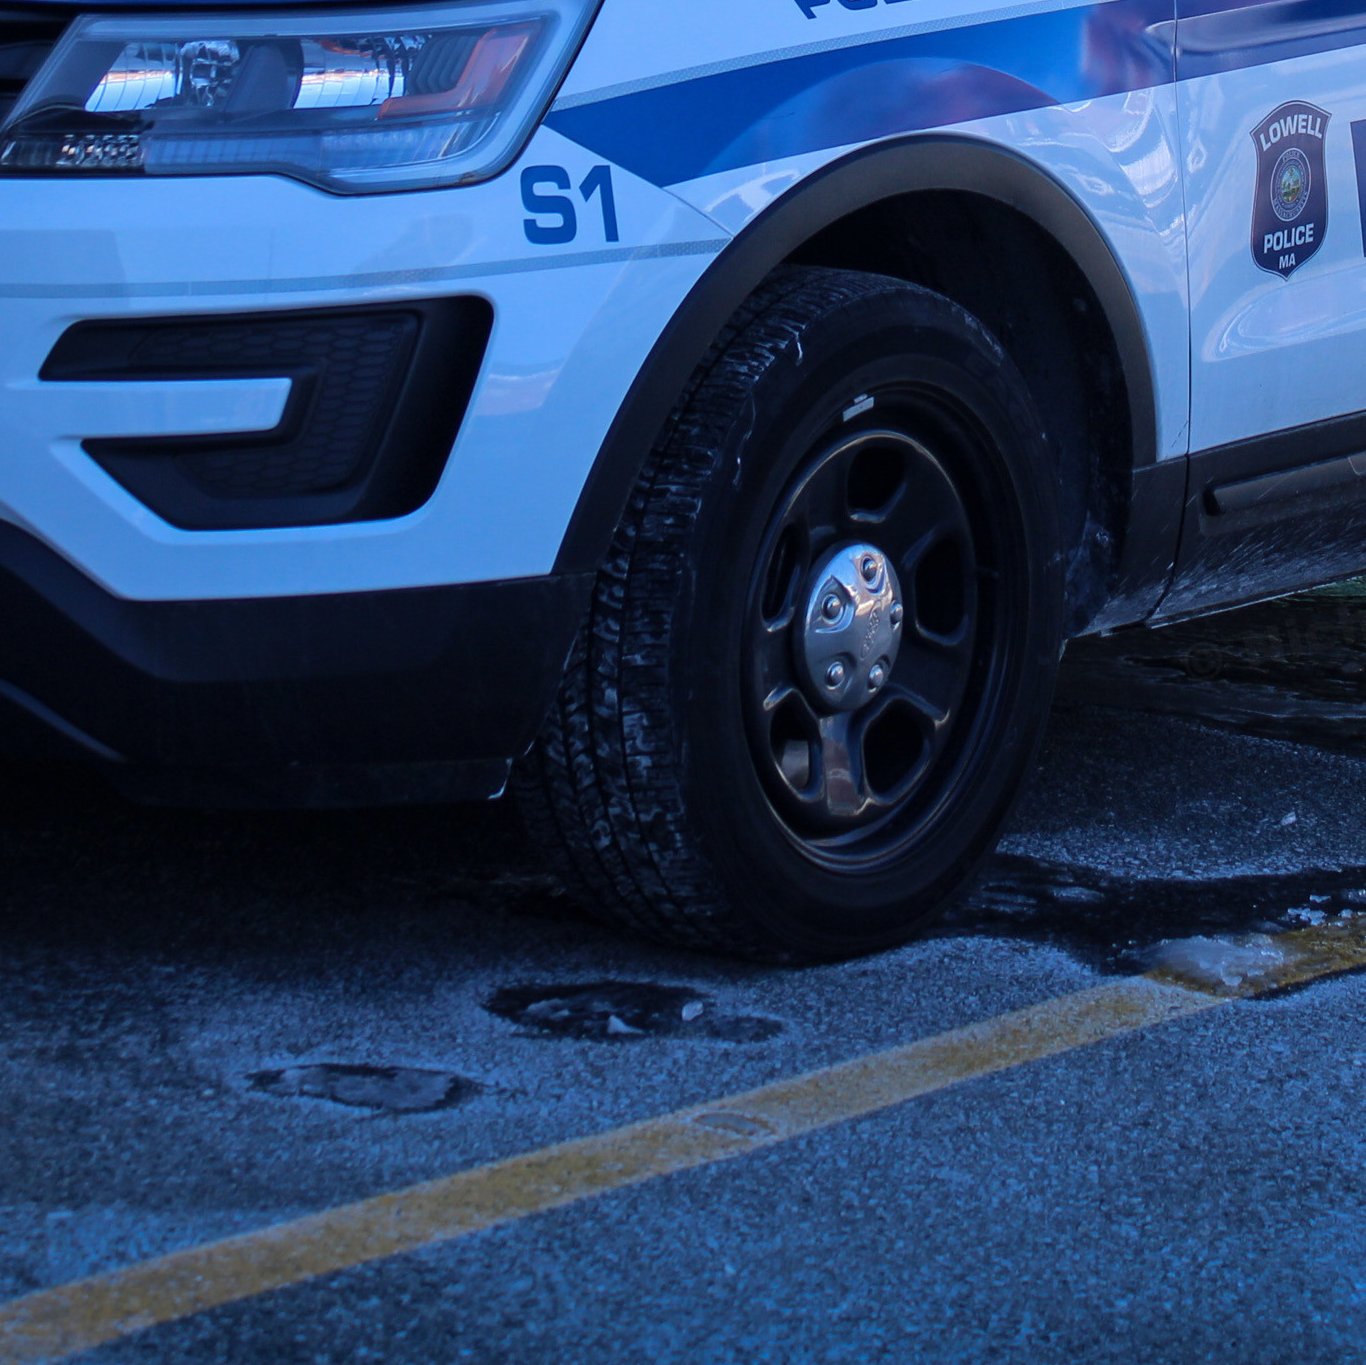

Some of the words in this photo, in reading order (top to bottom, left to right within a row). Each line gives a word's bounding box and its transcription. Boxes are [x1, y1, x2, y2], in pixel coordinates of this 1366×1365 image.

[1260, 114, 1323, 152] LOWELL
[520, 164, 619, 245] S1
[1263, 223, 1314, 254] POLICE
[1279, 253, 1296, 269] MA
